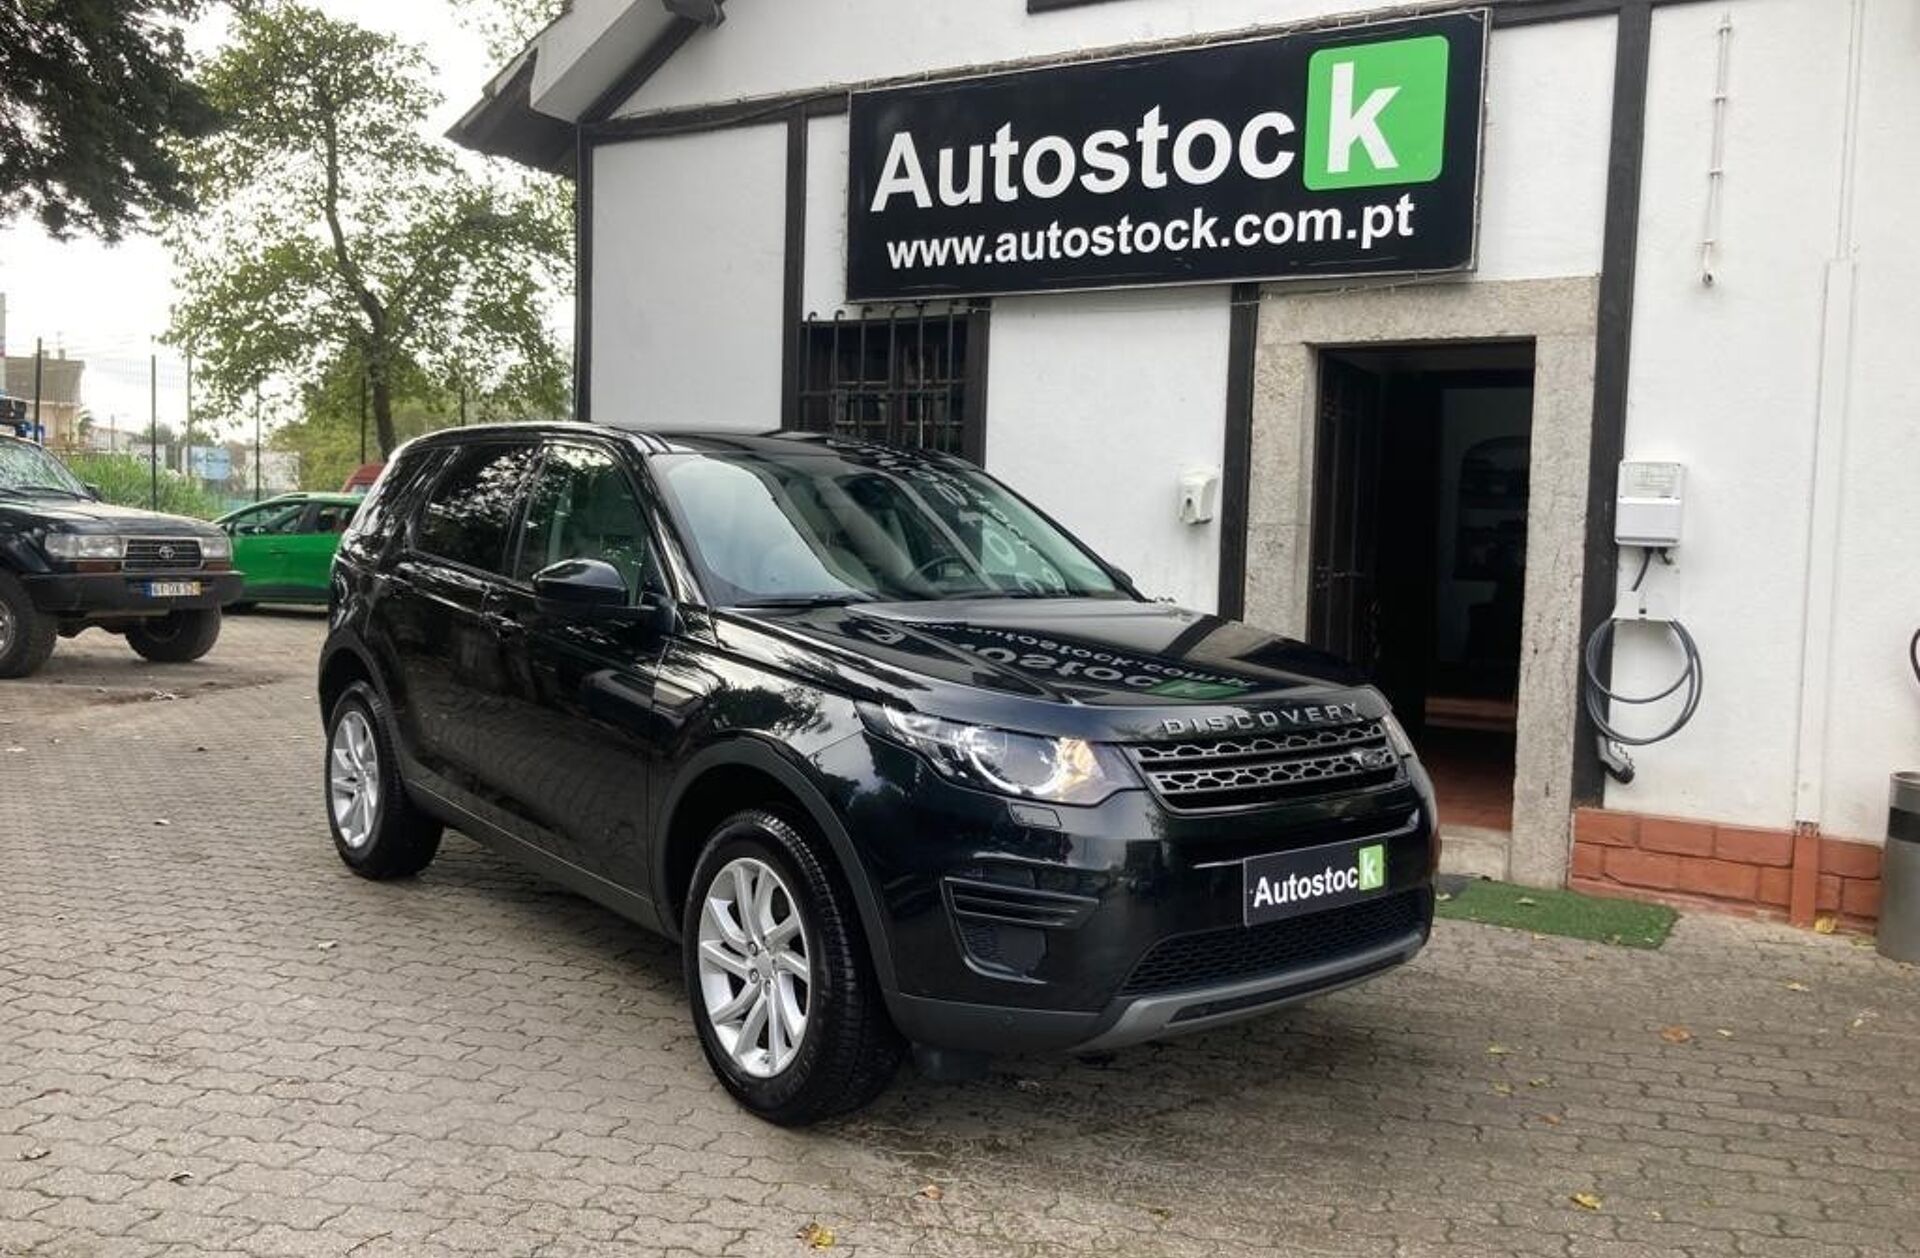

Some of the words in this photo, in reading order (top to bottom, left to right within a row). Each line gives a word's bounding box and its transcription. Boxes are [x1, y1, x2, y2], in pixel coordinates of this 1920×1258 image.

[870, 62, 1402, 213] Autostock
[887, 193, 1415, 271] www.autostock.com.pt
[1161, 703, 1359, 735] DISCOVERY
[1253, 852, 1377, 908] Autostock
